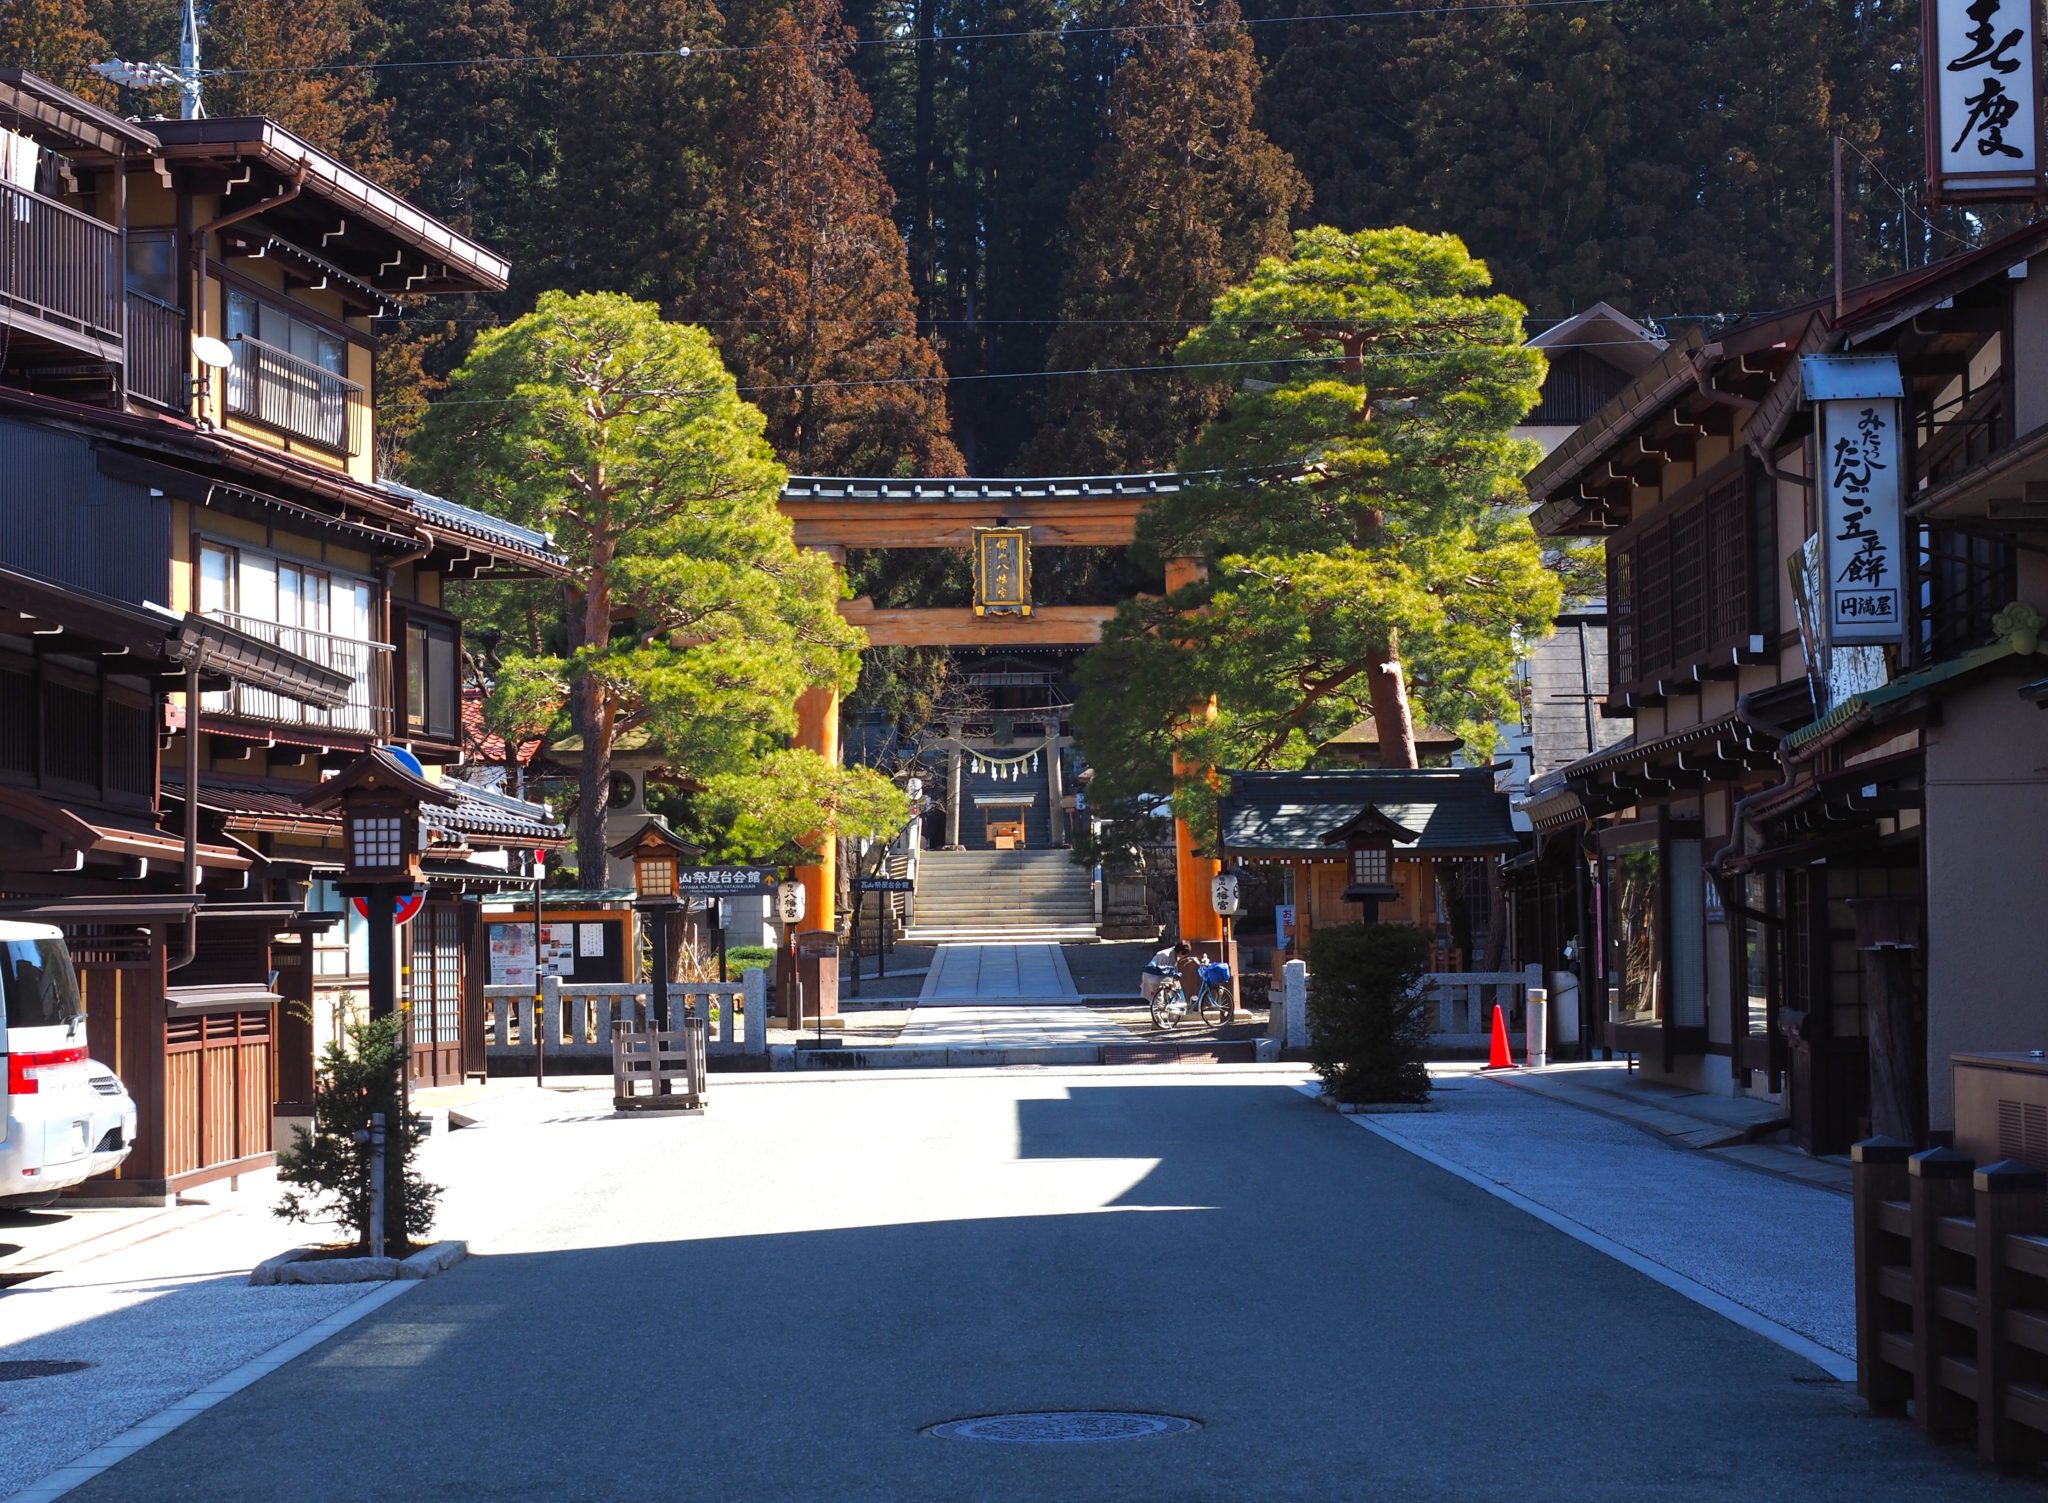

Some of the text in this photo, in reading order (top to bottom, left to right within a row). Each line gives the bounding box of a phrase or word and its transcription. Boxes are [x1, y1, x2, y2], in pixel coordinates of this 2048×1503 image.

[1858, 408, 1887, 470] みたらし
[1841, 595, 1892, 617] 円満屋
[679, 871, 760, 884] 山祭屋台会館
